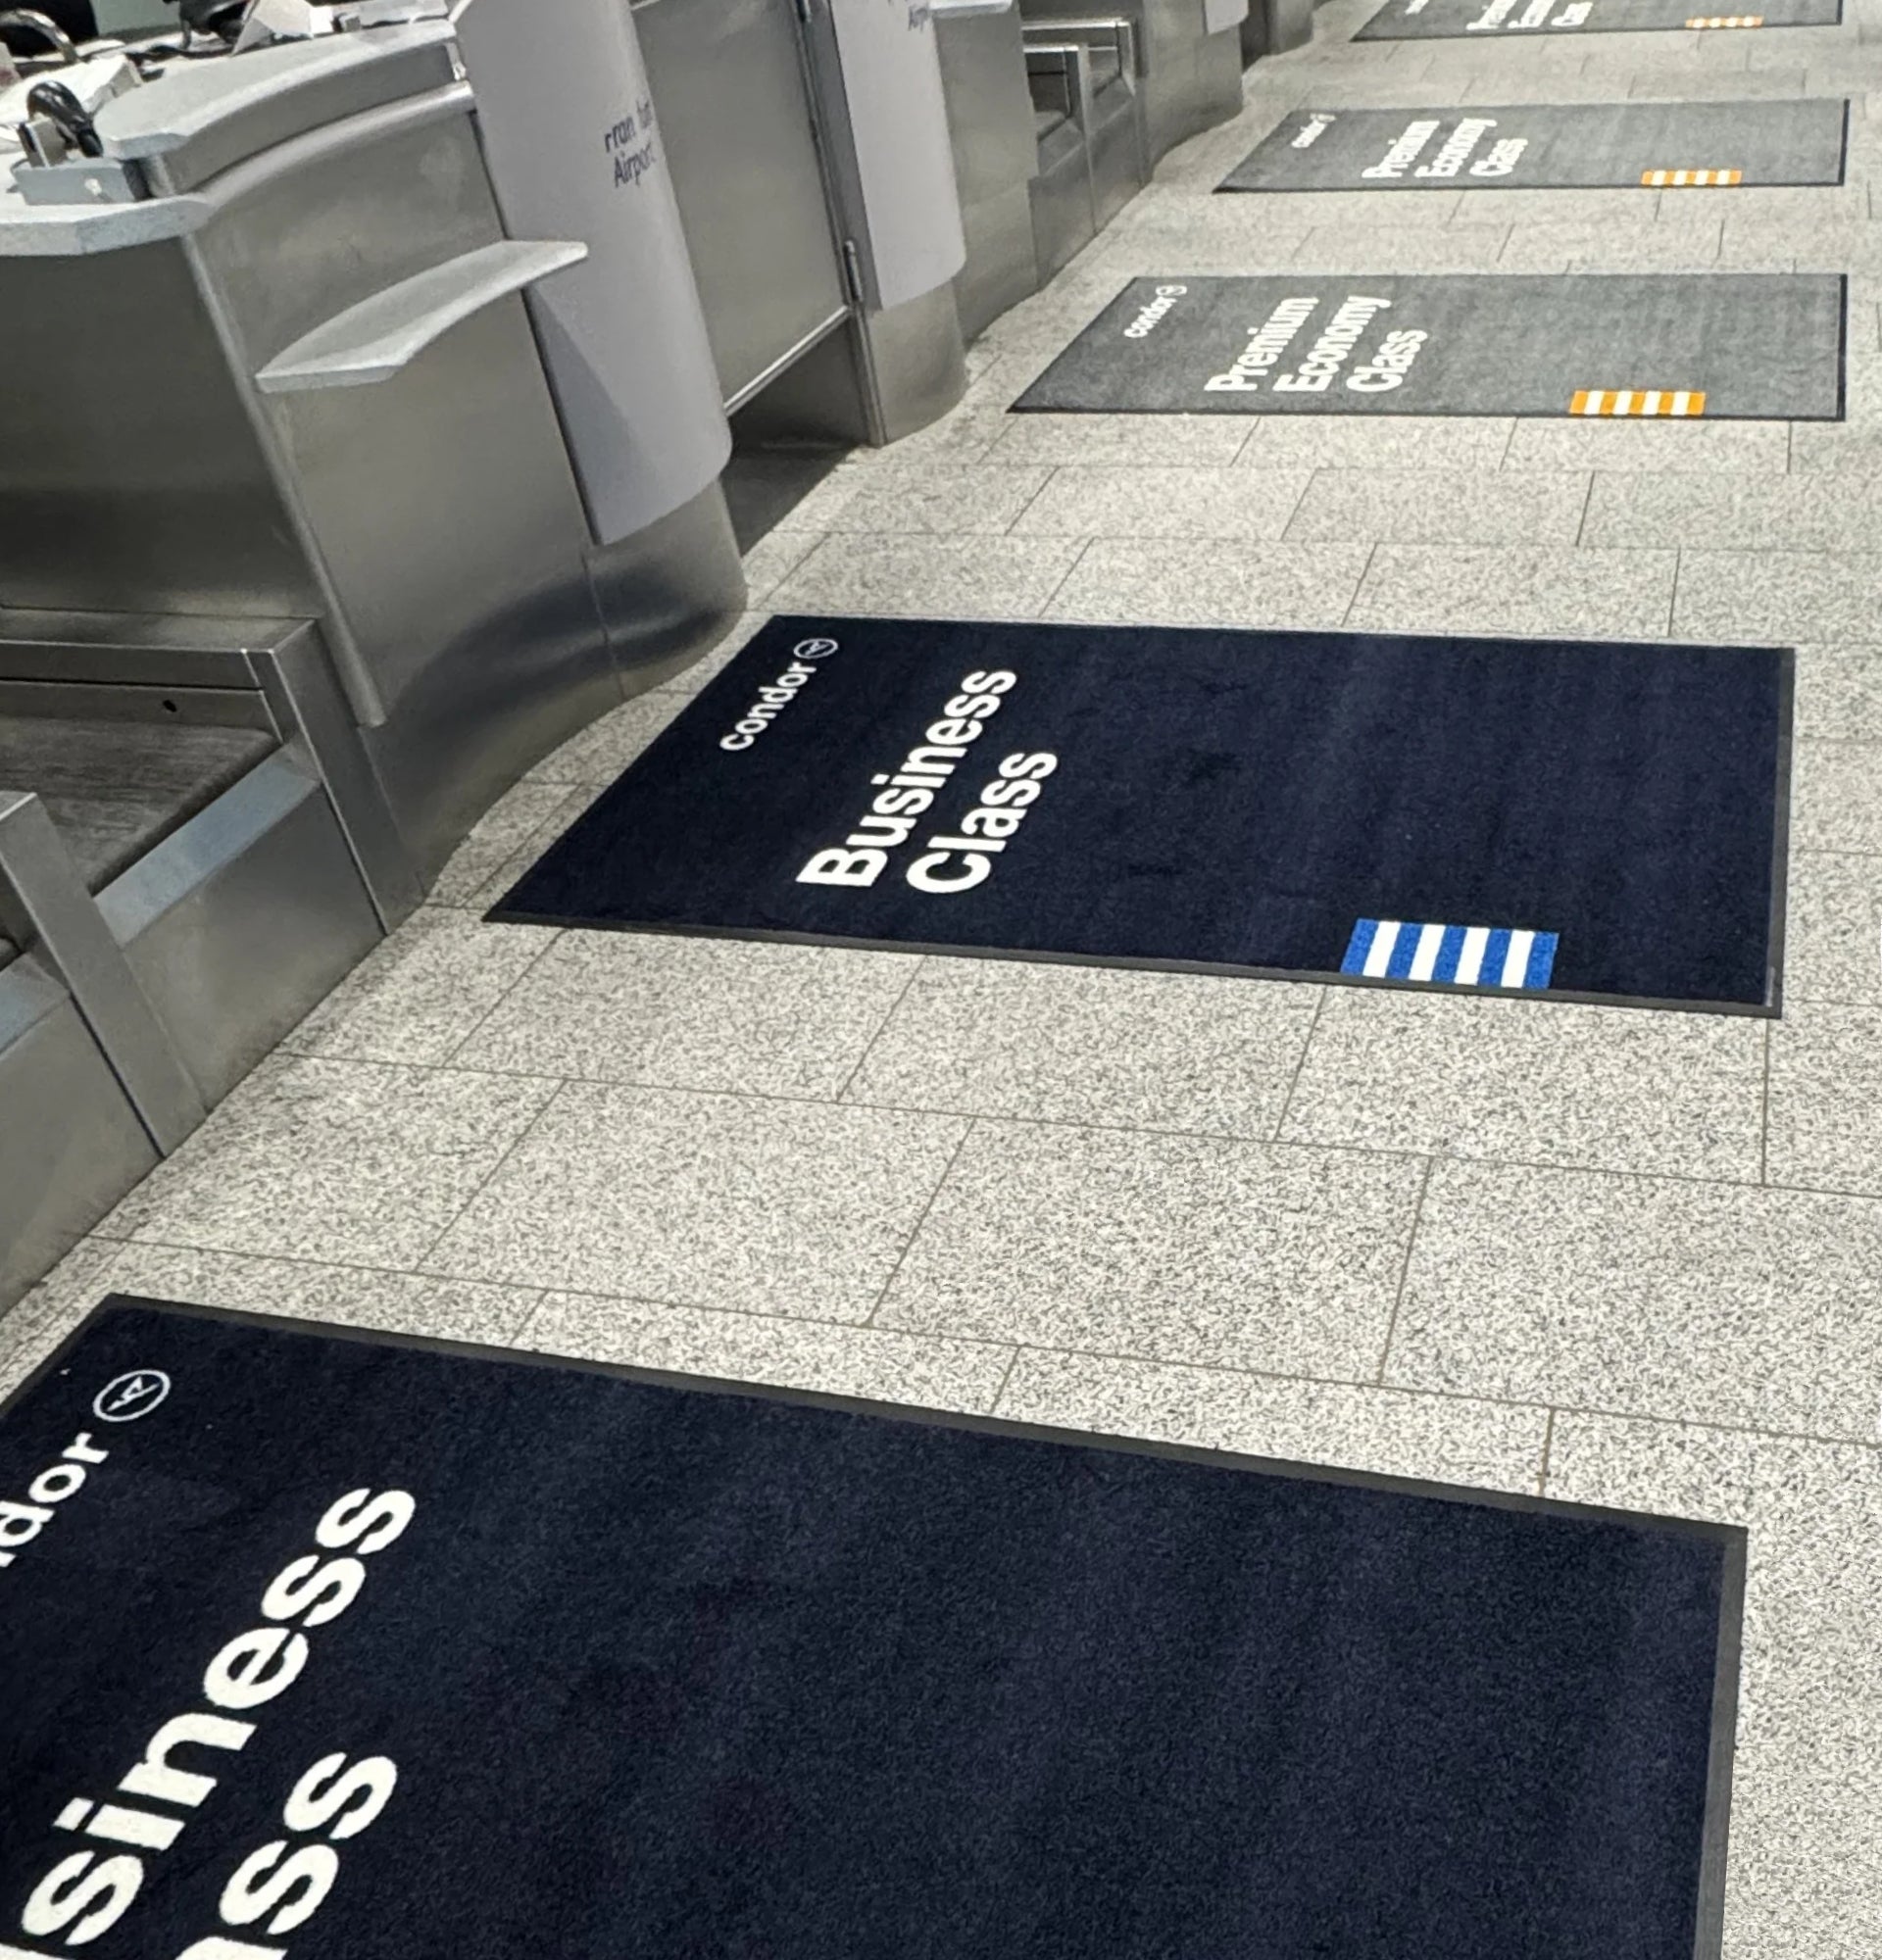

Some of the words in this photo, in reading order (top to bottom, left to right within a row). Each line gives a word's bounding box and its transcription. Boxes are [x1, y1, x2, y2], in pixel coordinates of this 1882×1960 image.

[1204, 297, 1319, 391] Premium
[1272, 296, 1392, 391] Economy
[1346, 329, 1428, 392] Class
[719, 662, 817, 751] condor
[795, 670, 1017, 887] Business
[906, 753, 1058, 894] Class
[0, 1433, 109, 1568] dor
[0, 1488, 417, 1960] siness
